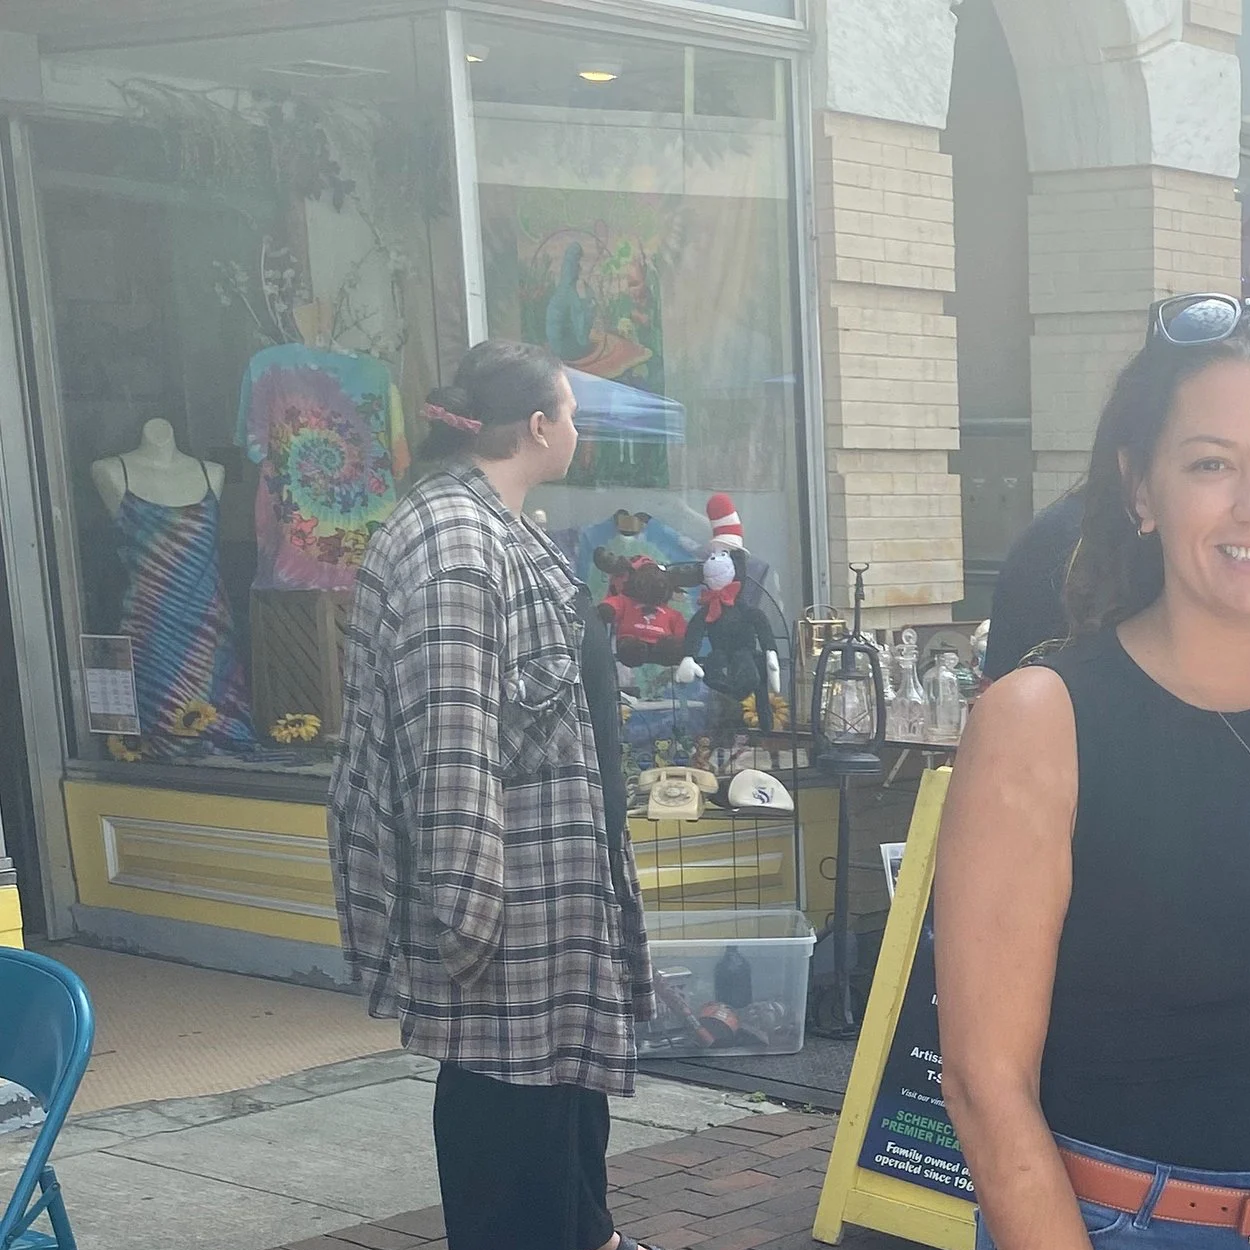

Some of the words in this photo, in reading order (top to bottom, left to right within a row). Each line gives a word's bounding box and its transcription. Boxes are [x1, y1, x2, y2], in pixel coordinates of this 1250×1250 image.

[910, 1046, 943, 1065] Artisa
[927, 1069, 943, 1084] T-S
[900, 1087, 917, 1099] Visit
[917, 1094, 930, 1103] our
[930, 1097, 946, 1108] vint
[880, 1118, 934, 1143] PREMIER
[935, 1134, 962, 1152] HEA
[896, 1110, 956, 1137] SCHENEC
[886, 1141, 922, 1164] Family
[923, 1155, 960, 1173] owned
[874, 1154, 922, 1175] operated
[923, 1168, 951, 1184] since
[953, 1176, 975, 1192] 196
